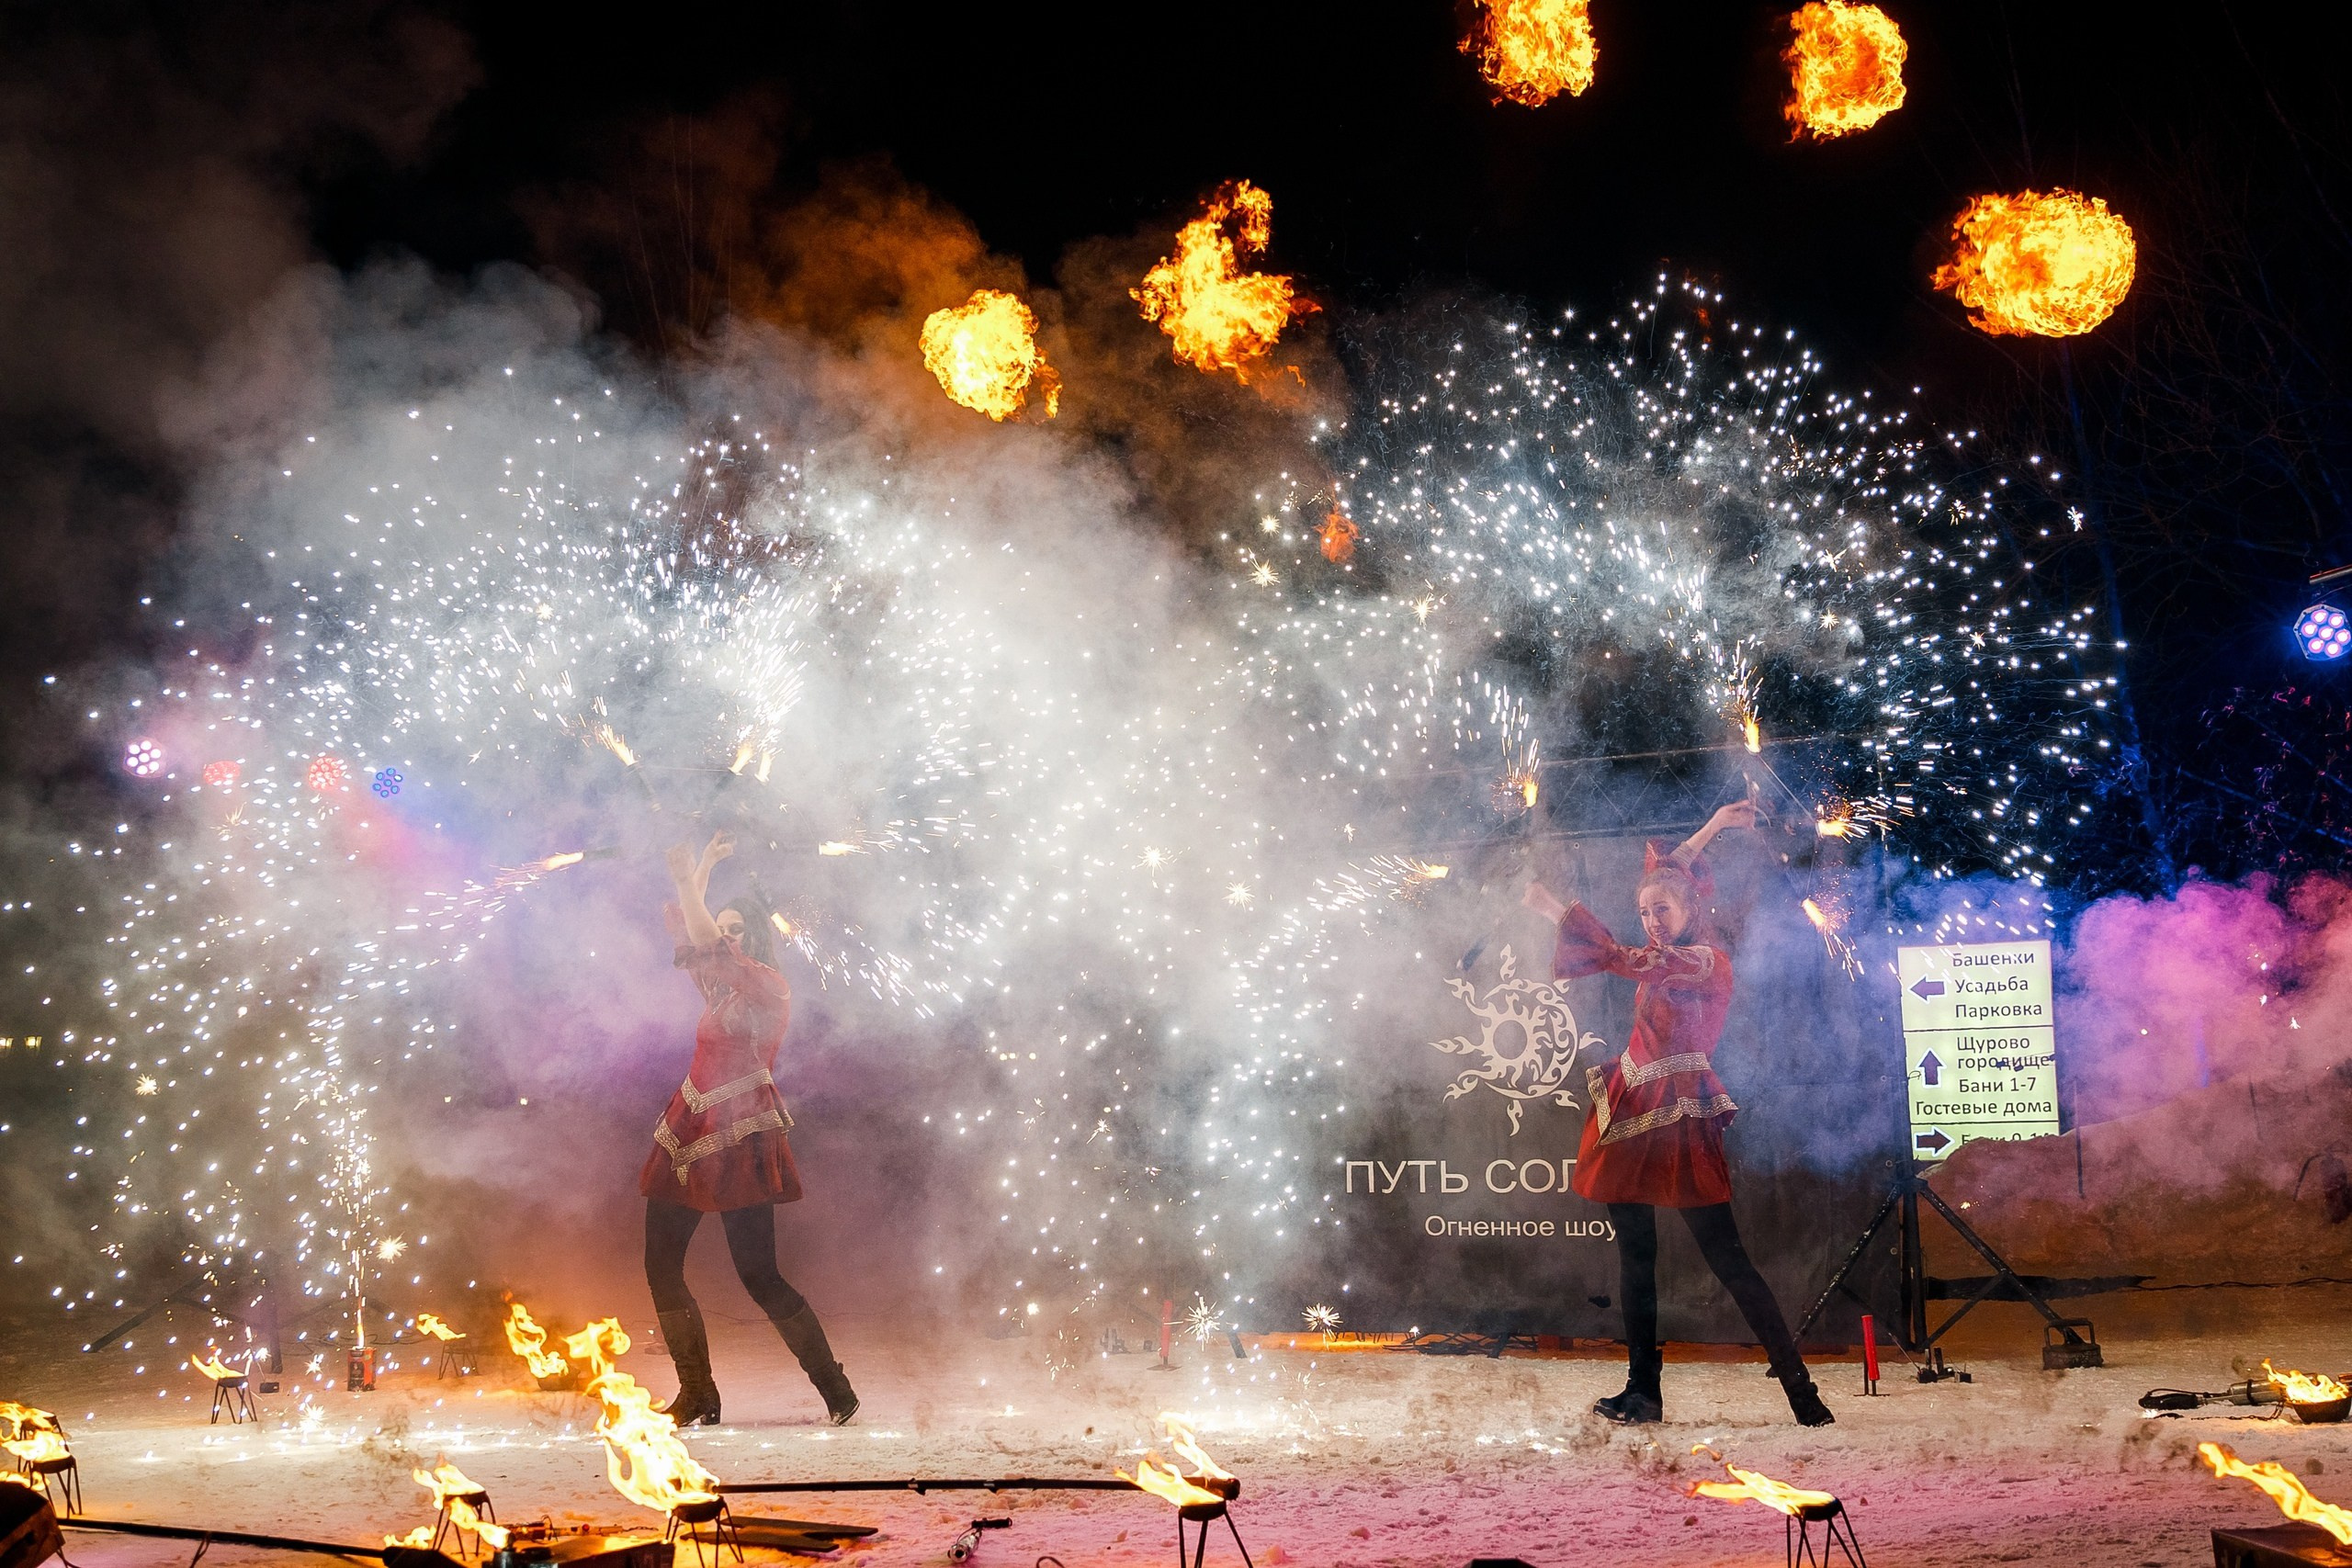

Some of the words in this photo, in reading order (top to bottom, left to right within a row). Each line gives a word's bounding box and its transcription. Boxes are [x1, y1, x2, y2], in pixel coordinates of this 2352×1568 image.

[1952, 952, 2034, 966] Башенки
[1955, 976, 2029, 995] Усадьба
[1955, 1003, 2042, 1020] Парковка
[1957, 1036, 2030, 1054] Щурово
[1958, 1055, 2050, 1071] городище
[1959, 1078, 2004, 1092] Бани
[2010, 1077, 2037, 1091] 1-7
[1916, 1101, 1997, 1115] Гостевые
[2003, 1100, 2052, 1116] дома
[1346, 1160, 1469, 1193] ПУТЬ
[1425, 1215, 1555, 1236] Огненное
[1566, 1220, 1616, 1242] шоу
